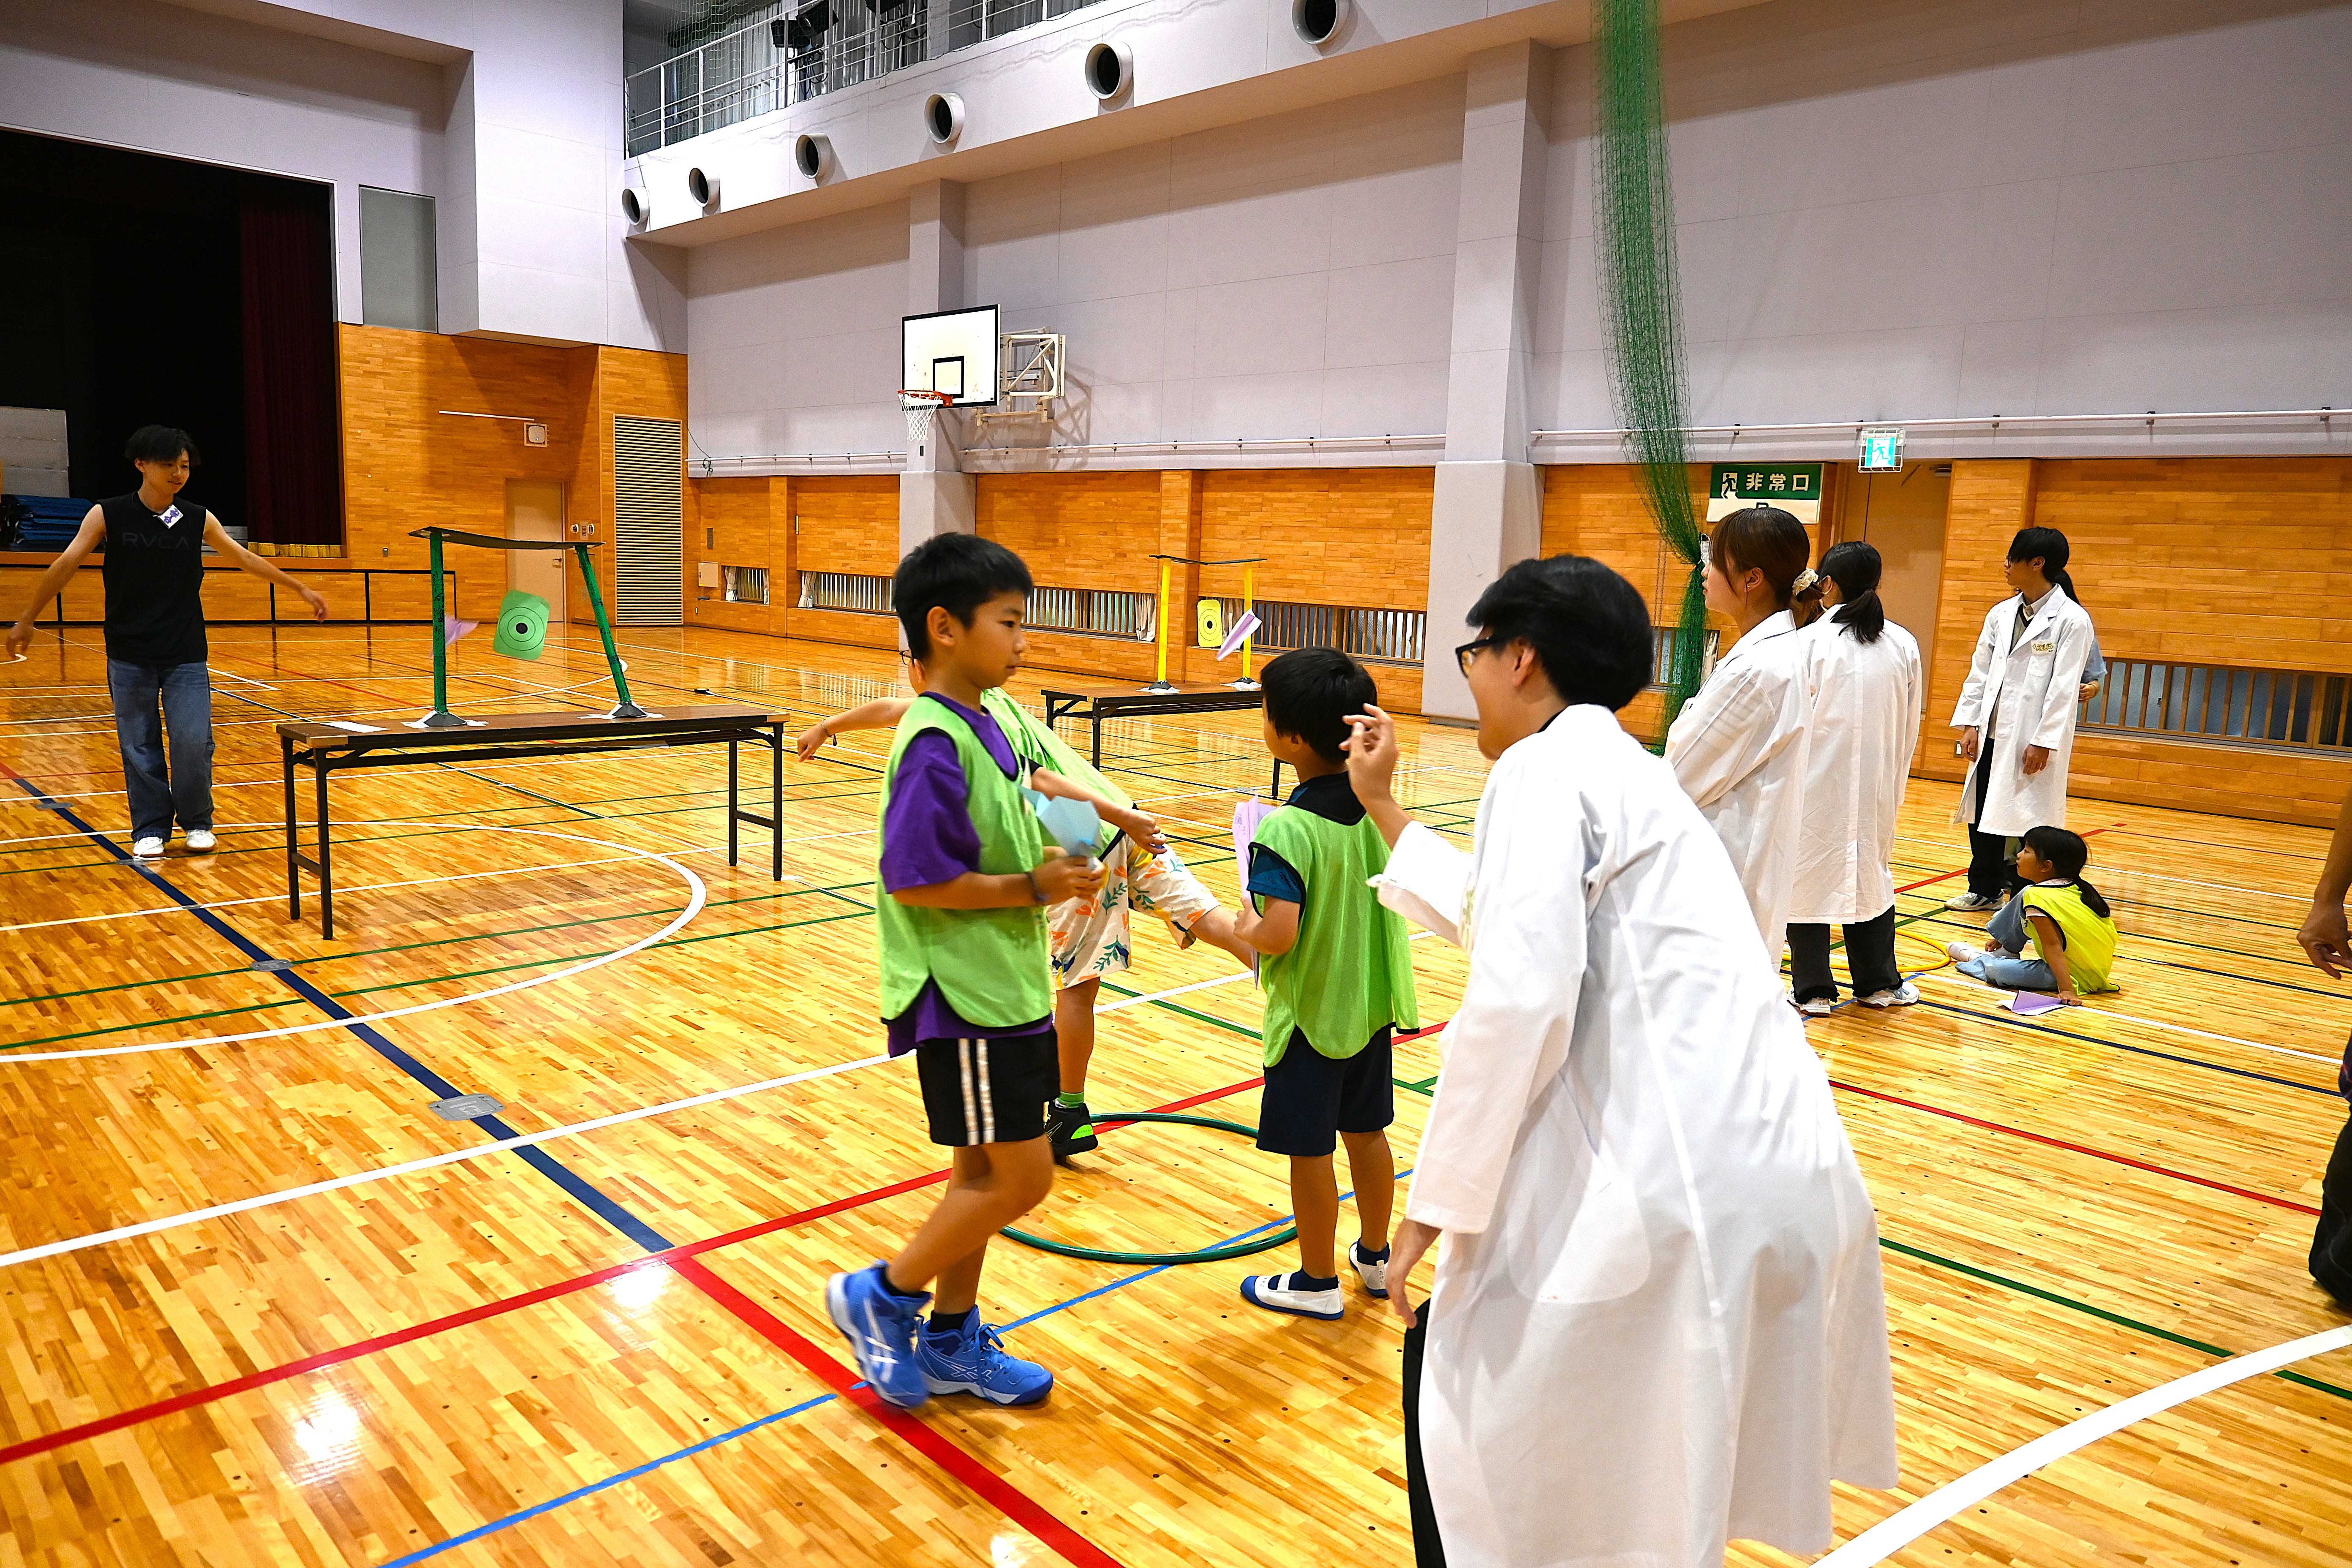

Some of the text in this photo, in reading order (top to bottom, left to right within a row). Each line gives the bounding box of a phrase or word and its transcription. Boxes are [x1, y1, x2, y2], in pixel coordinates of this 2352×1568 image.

[1746, 472, 1809, 491] 非常口
[122, 532, 190, 550] RVCA
